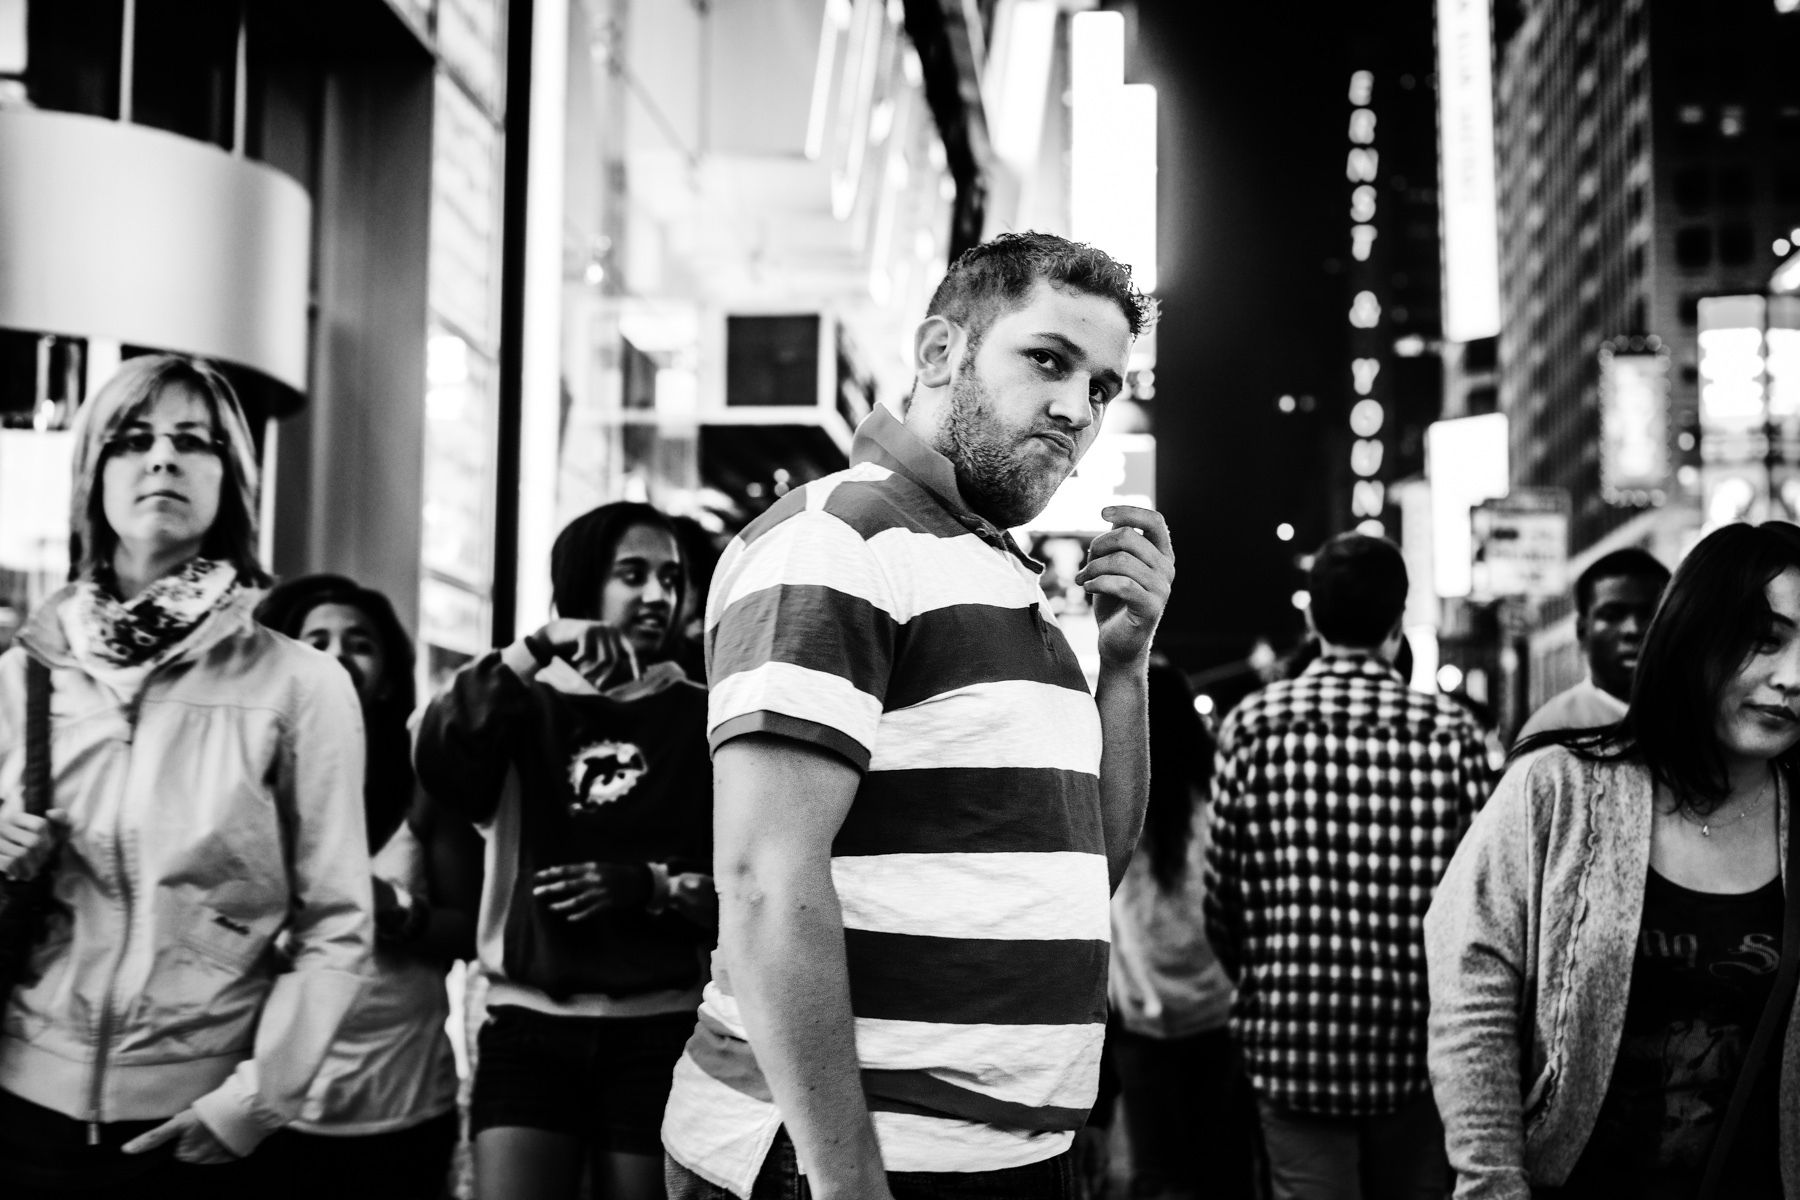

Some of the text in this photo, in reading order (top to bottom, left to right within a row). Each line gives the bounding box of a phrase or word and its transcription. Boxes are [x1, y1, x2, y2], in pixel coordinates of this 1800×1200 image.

[1346, 70, 1379, 262] ERNST
[1640, 929, 1781, 978] ng S
